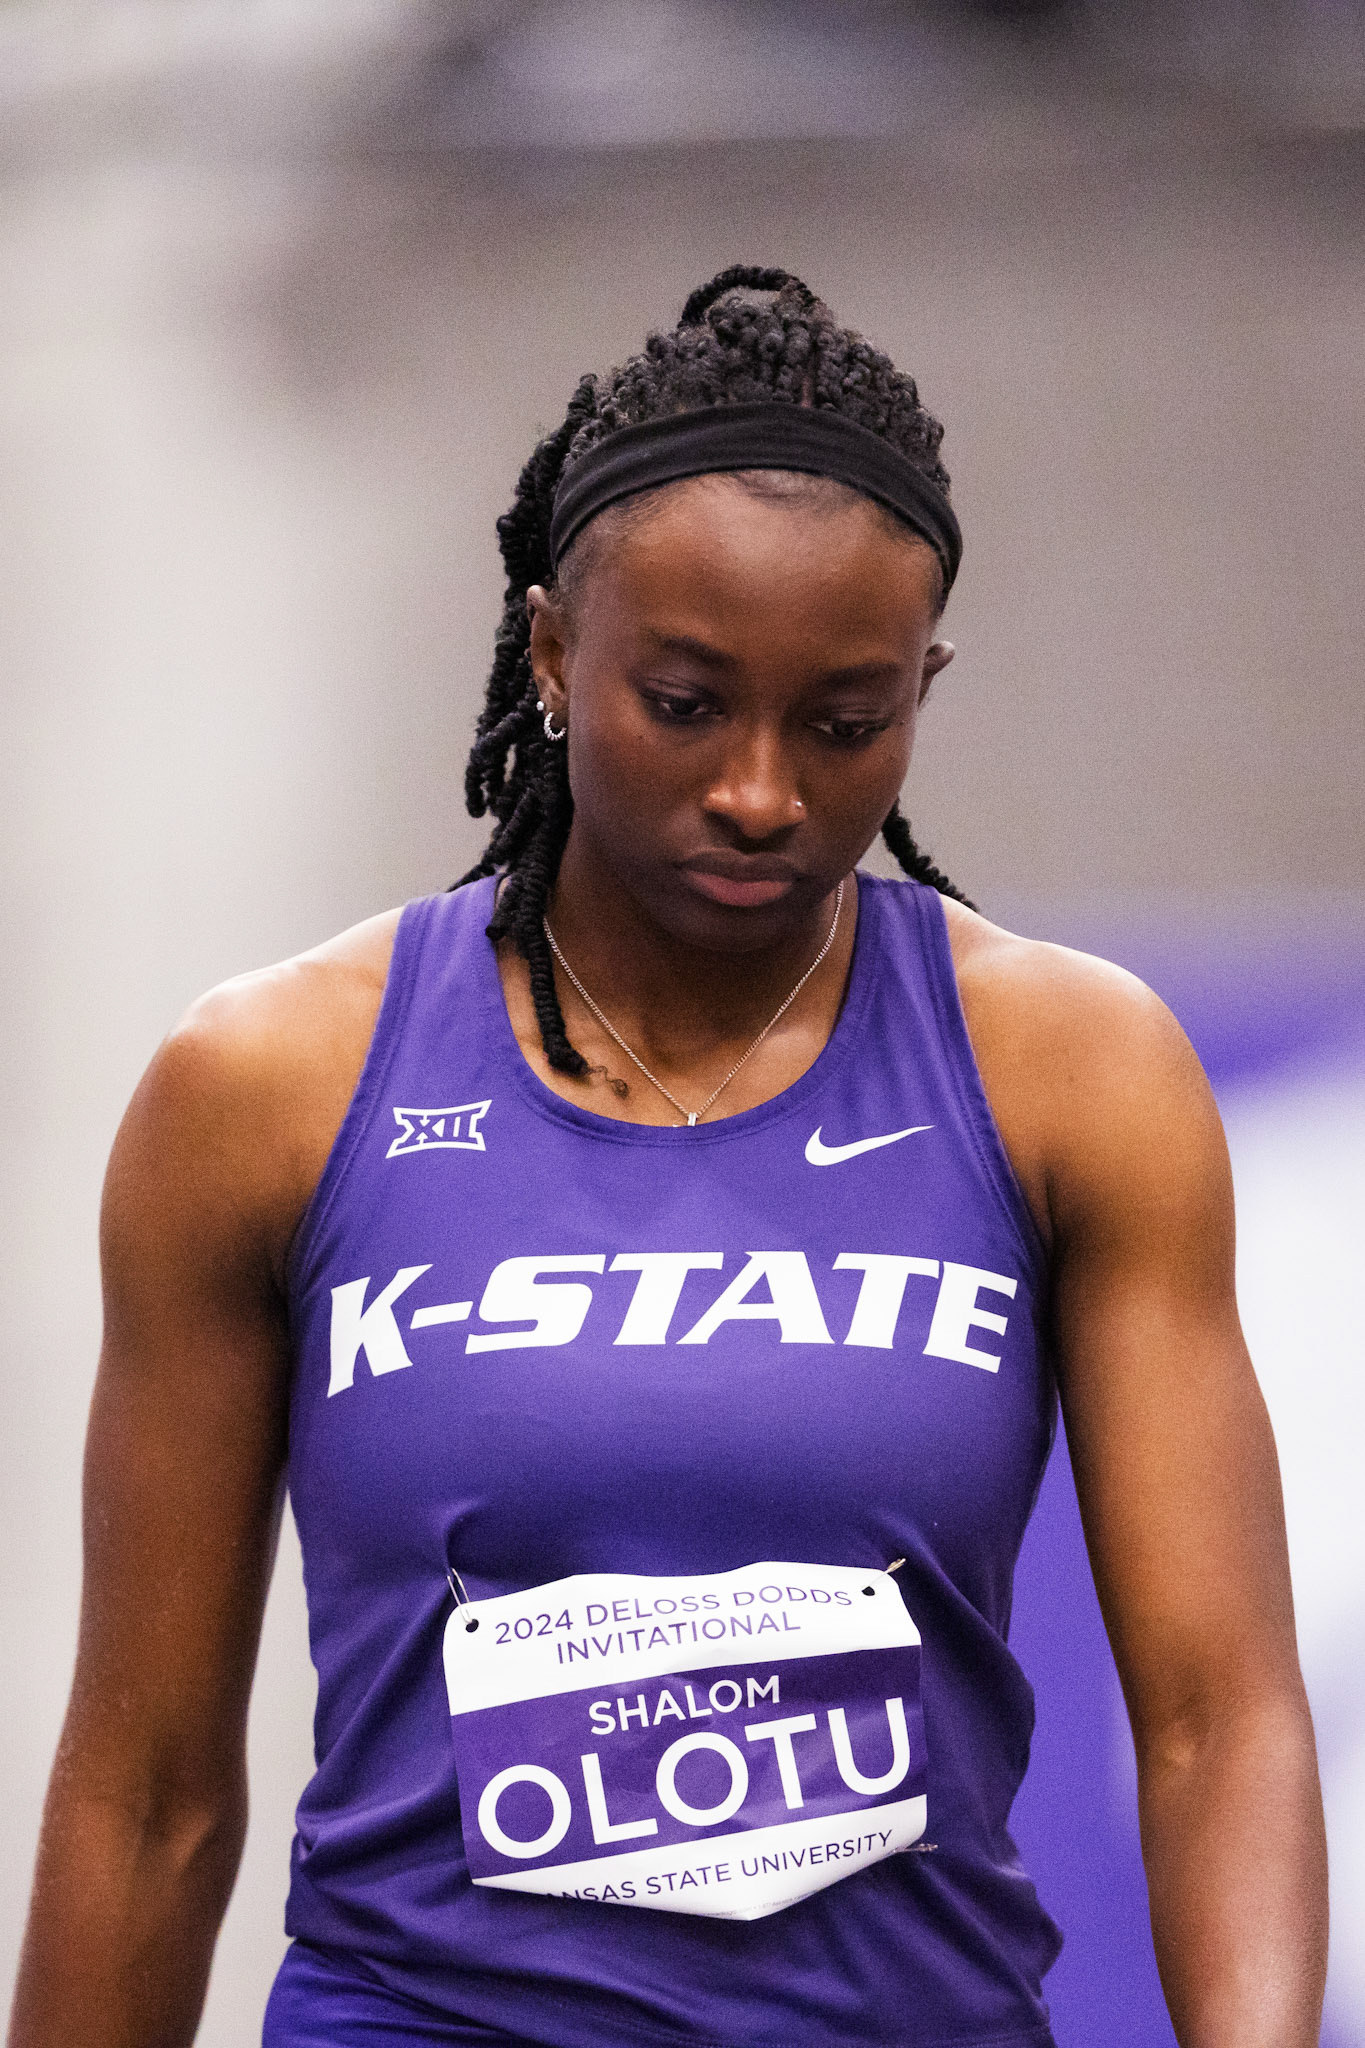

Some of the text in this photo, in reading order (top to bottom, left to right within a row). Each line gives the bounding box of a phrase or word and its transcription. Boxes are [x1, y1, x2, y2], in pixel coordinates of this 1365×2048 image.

[327, 1250, 1018, 1399] K-STATE
[494, 1585, 853, 1645] 2024 DELOSS DODDS
[557, 1611, 801, 1665] INVITATIONAL
[588, 1674, 781, 1736] SHALOM
[477, 1696, 912, 1859] OLOTU
[546, 1828, 894, 1901] NSAS STATE UNIVERSITY
